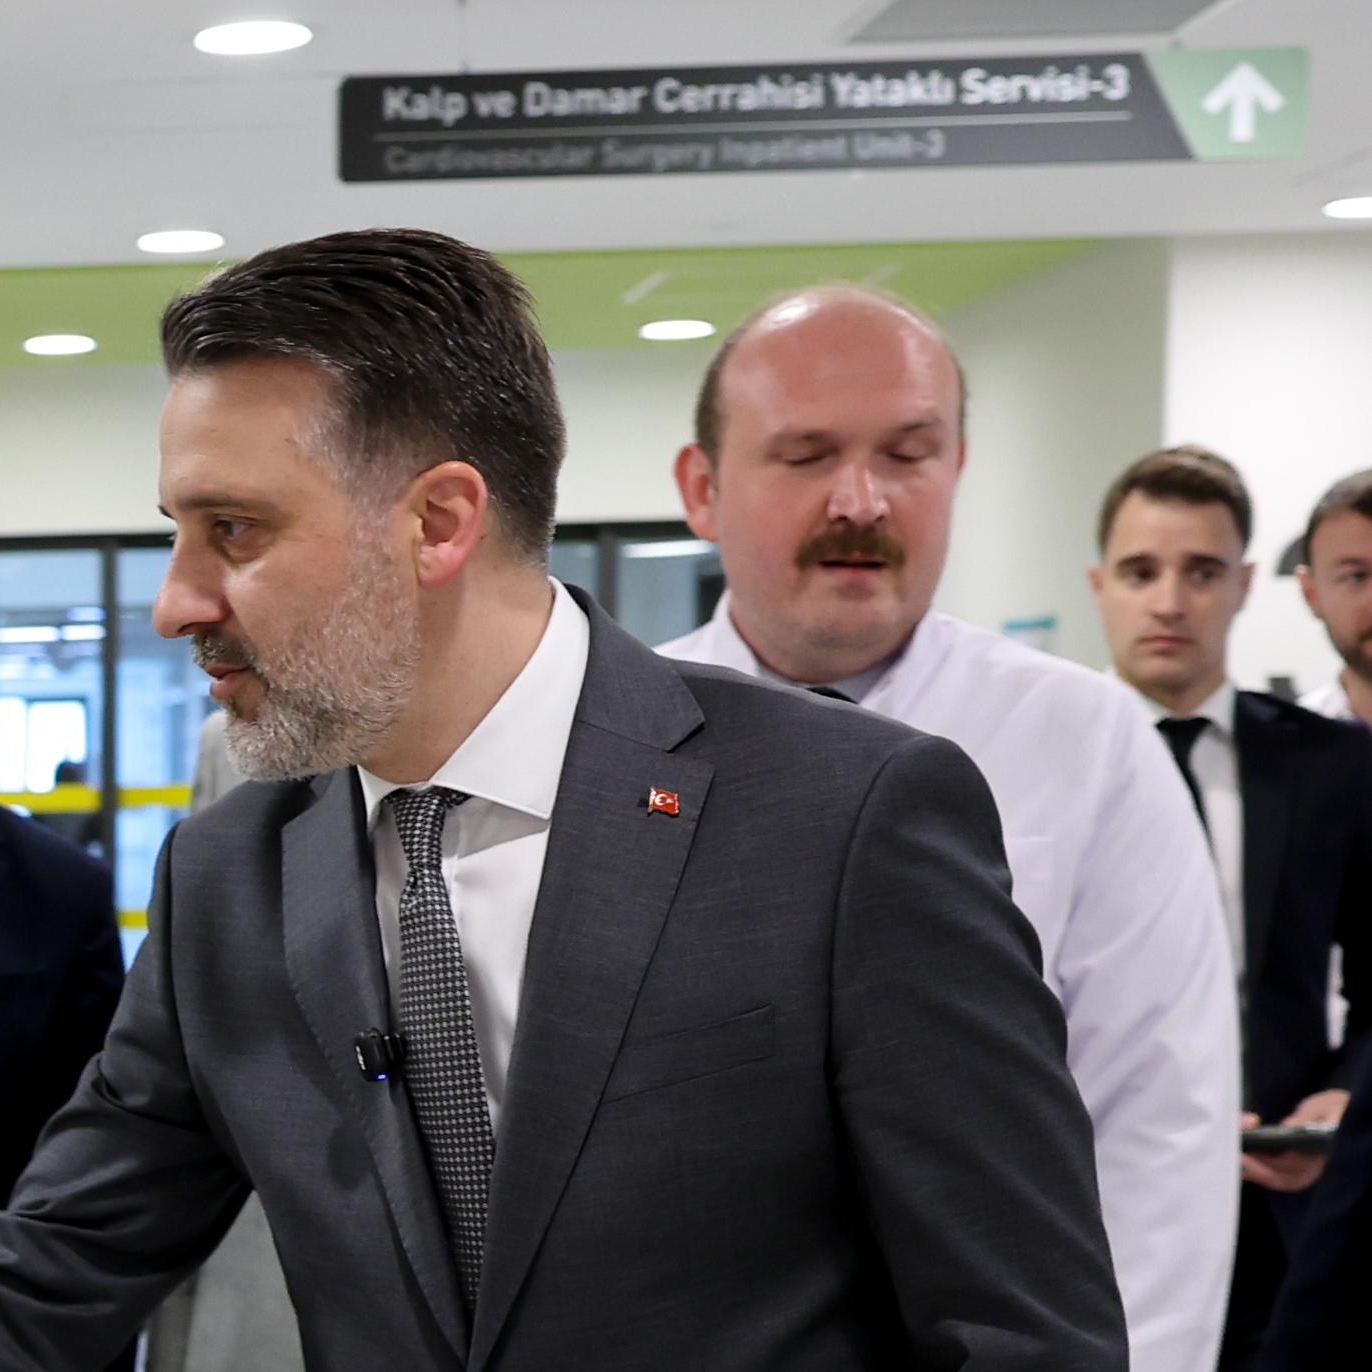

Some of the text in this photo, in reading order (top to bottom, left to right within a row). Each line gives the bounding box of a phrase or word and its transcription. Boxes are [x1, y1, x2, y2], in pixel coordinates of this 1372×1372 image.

[382, 64, 1130, 127] Kalp ve Damar Cerrahisi Yataklı Servisi-3
